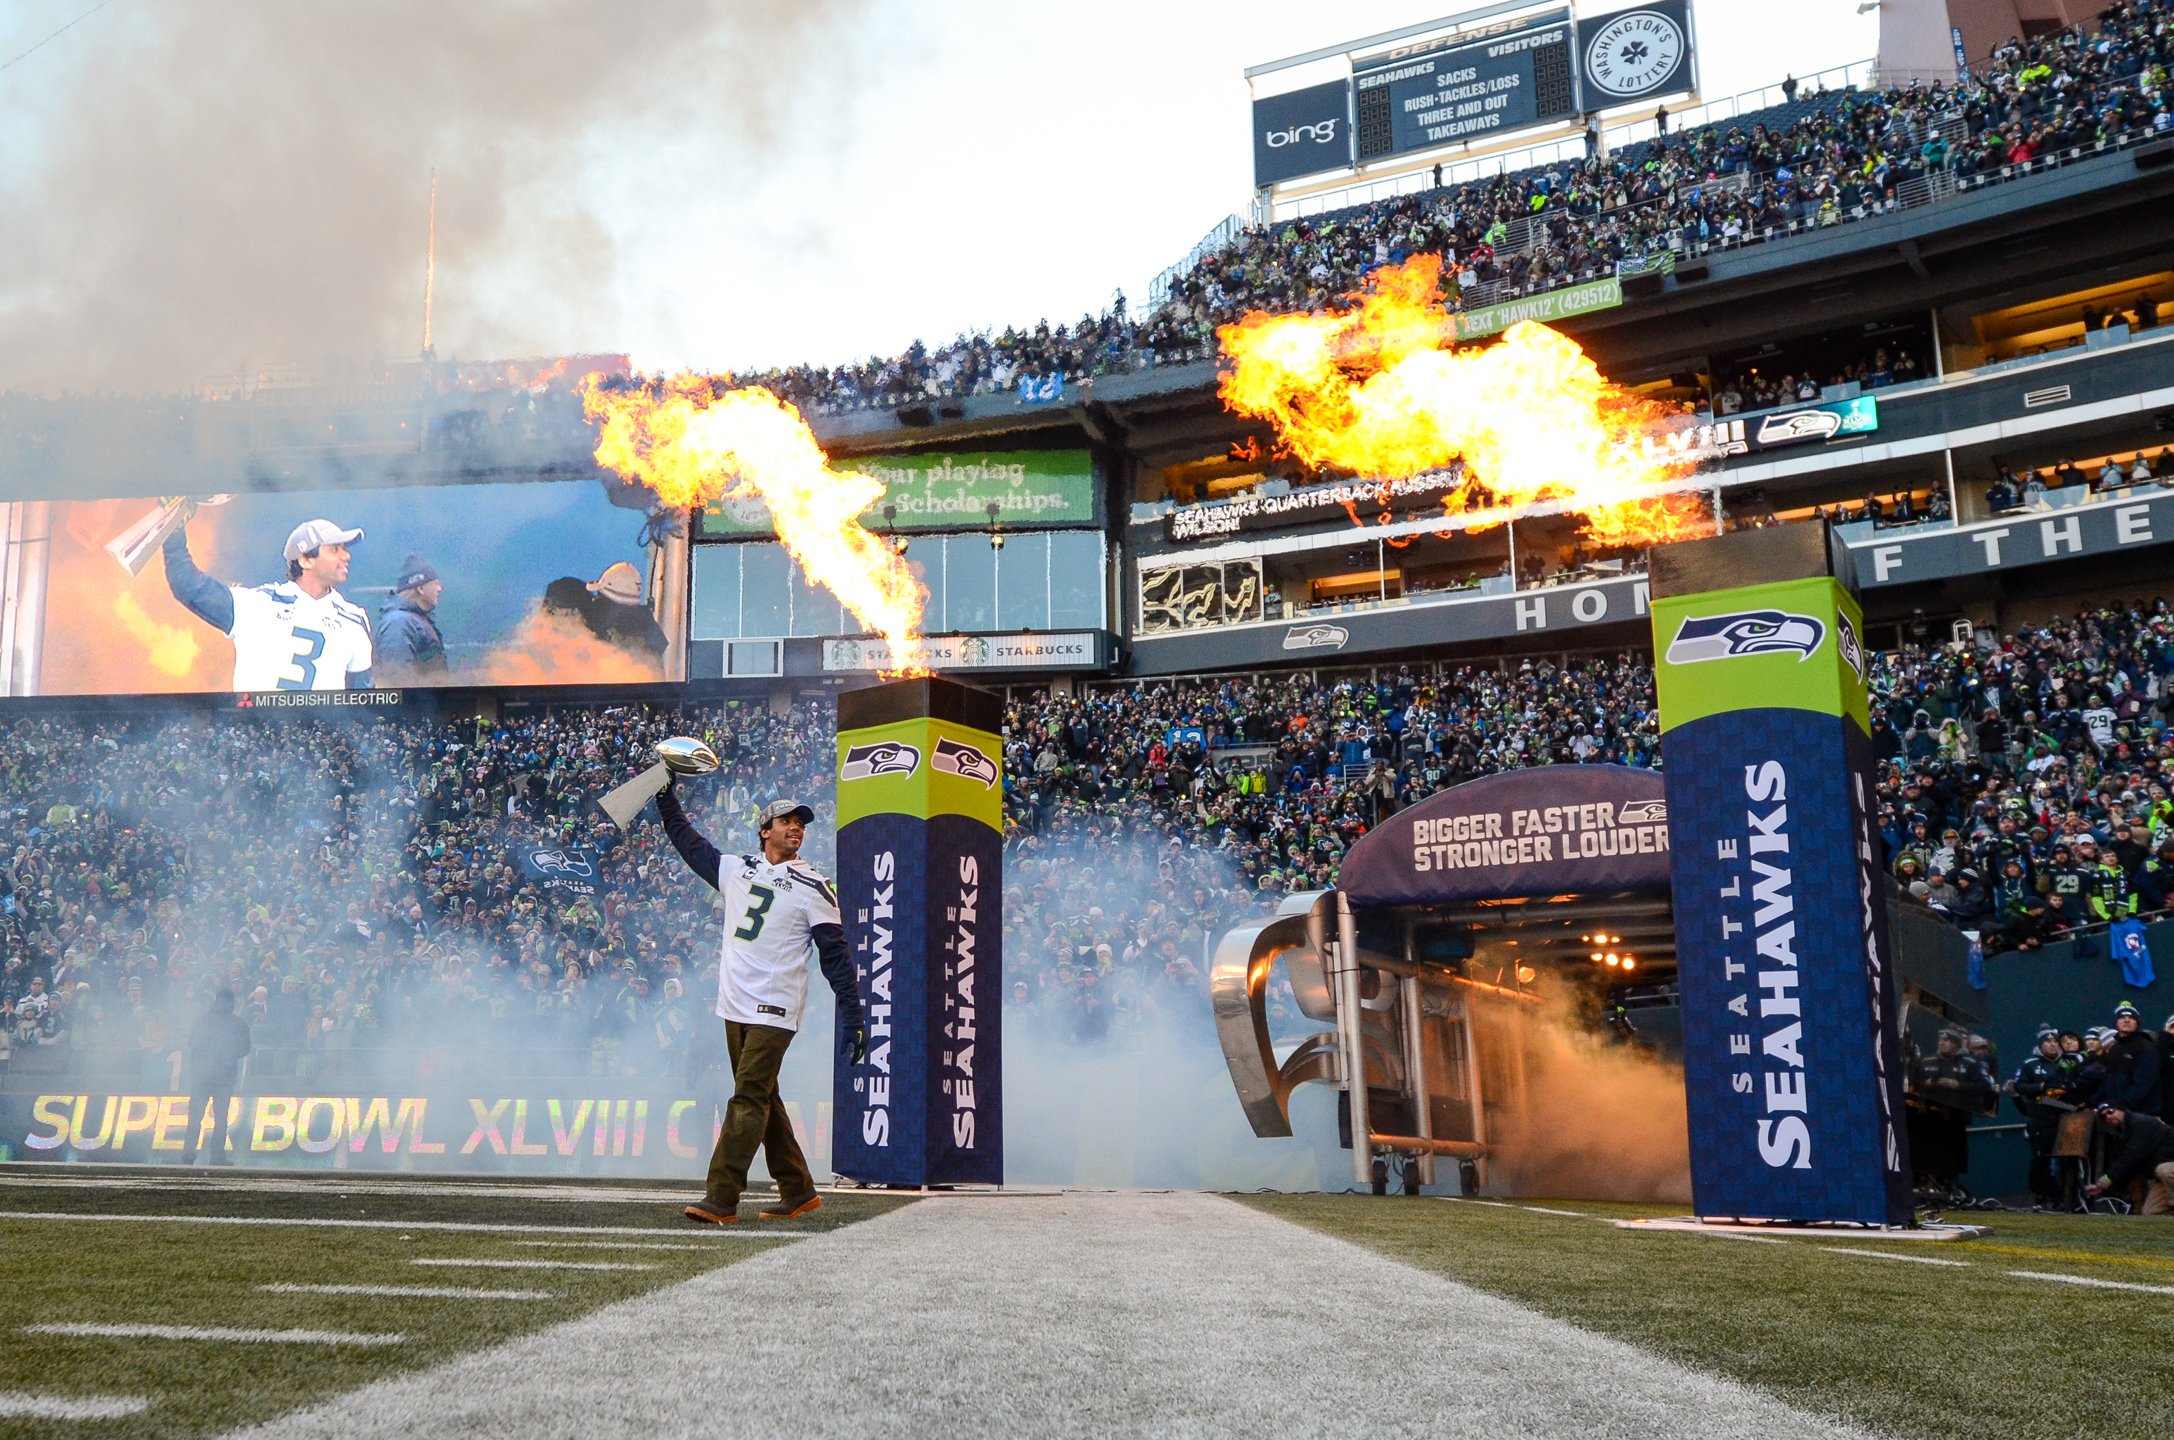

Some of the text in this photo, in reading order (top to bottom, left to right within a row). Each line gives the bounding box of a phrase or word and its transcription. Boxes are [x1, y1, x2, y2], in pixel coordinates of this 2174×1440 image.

[1389, 16, 1530, 60] DEFENSE
[1488, 30, 1563, 58] VISITORS
[1596, 19, 1672, 79] WASHINGTON'S
[1358, 61, 1435, 90] SEAHAWKS
[1437, 67, 1477, 87] SACKS
[1619, 53, 1672, 87] LOTTERY
[1418, 94, 1508, 126] THREE AND OUT
[1427, 114, 1501, 141] TAKEAWAYS
[1267, 119, 1335, 147] bing
[1558, 283, 1620, 315] (429512)
[926, 456, 1026, 488] playing
[1515, 581, 1649, 631] HO
[1972, 504, 2154, 566] THE
[276, 626, 326, 690] 3
[996, 644, 1084, 658] STARBUCKS
[256, 693, 399, 707] MITSUBISHI ELECTRIC
[2089, 715, 2108, 728] 29
[1414, 802, 1615, 844] BIGGER FASTER
[1414, 825, 1670, 871] STRONGER LOUDER
[2056, 875, 2080, 893] 29
[734, 884, 775, 942] 3
[1718, 838, 1753, 1093] SEATTLE
[1745, 760, 1812, 1169] SEAHAWKS
[863, 851, 895, 1147] SEAHAWKS
[943, 906, 957, 1095] SEATTLE
[953, 855, 979, 1149] SEAHAWKS
[251, 1096, 446, 1155] BOWL
[459, 1098, 649, 1158] XLVIII
